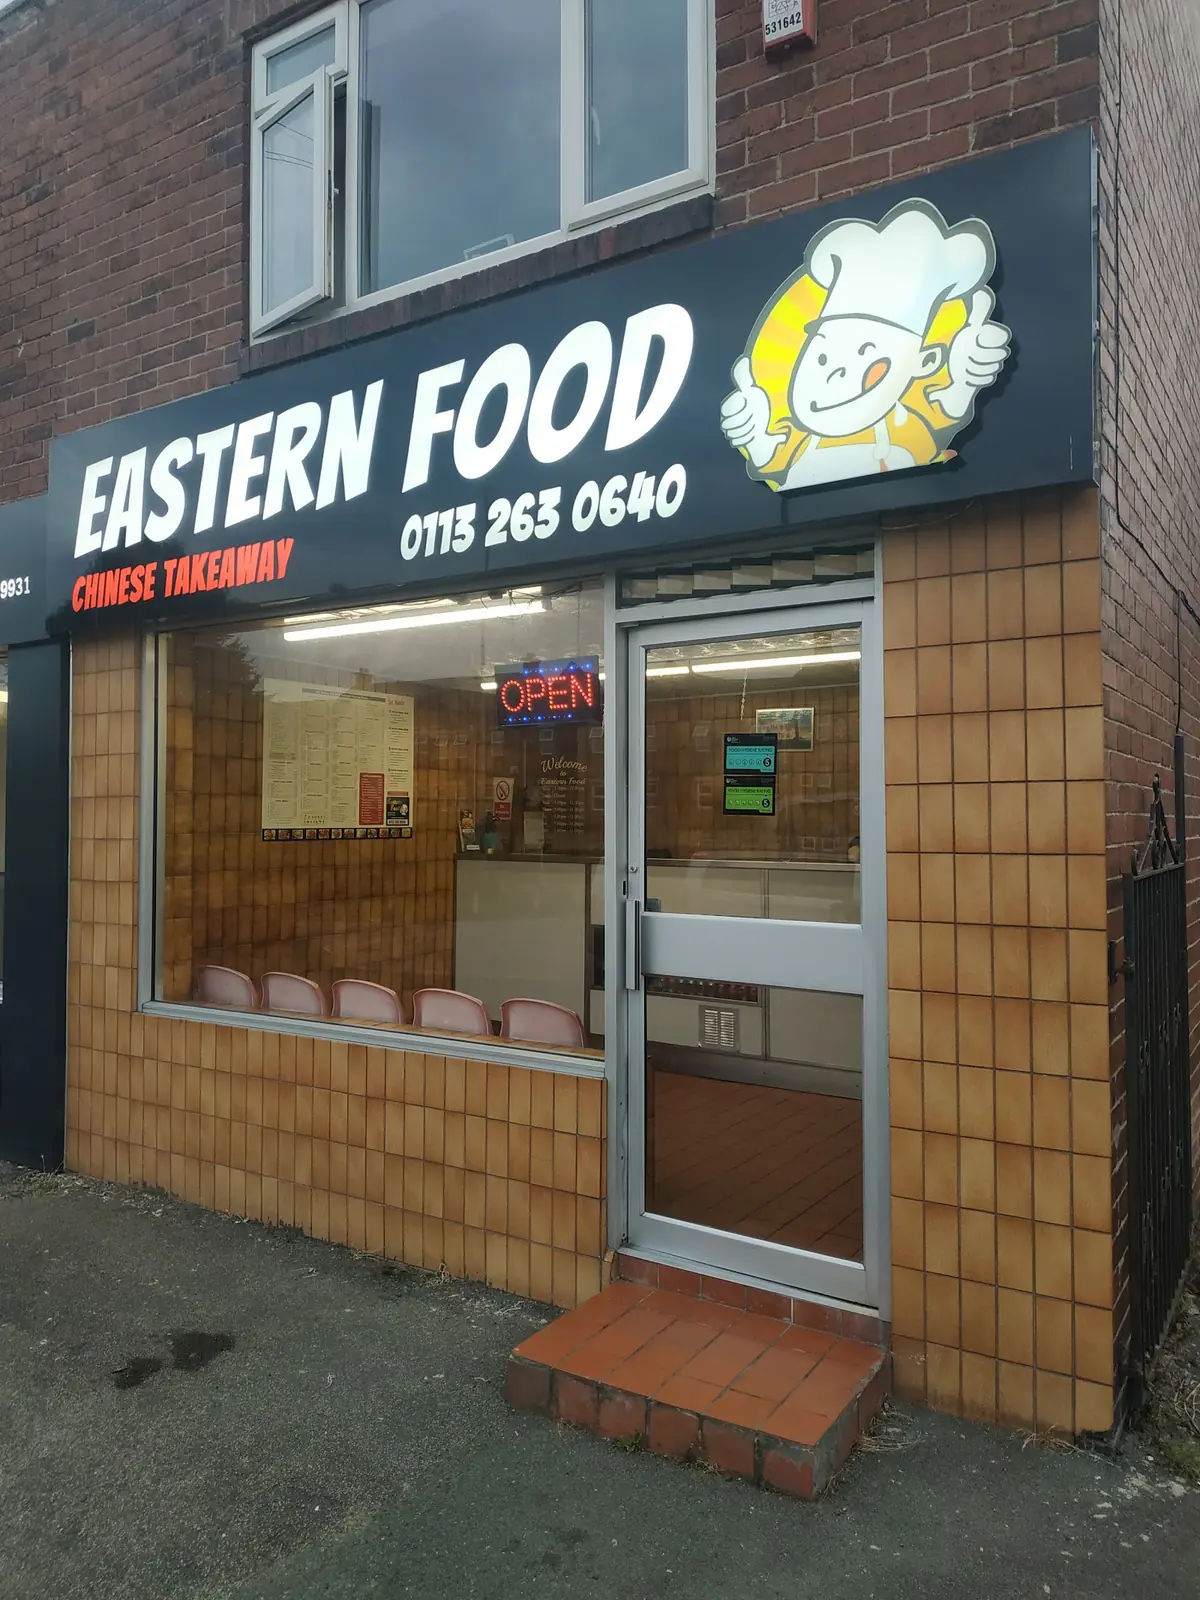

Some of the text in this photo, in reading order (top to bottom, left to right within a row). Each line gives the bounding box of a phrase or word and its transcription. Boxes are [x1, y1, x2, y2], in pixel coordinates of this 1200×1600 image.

[765, 12, 801, 36] 531642
[73, 303, 694, 559] EASTERN FOOD
[401, 463, 687, 561] 0113 263 0640
[0, 576, 30, 599] 9931
[71, 538, 294, 612] CHINESE TAKEAWAY
[501, 673, 593, 712] OPEN
[540, 756, 588, 773] Welcome
